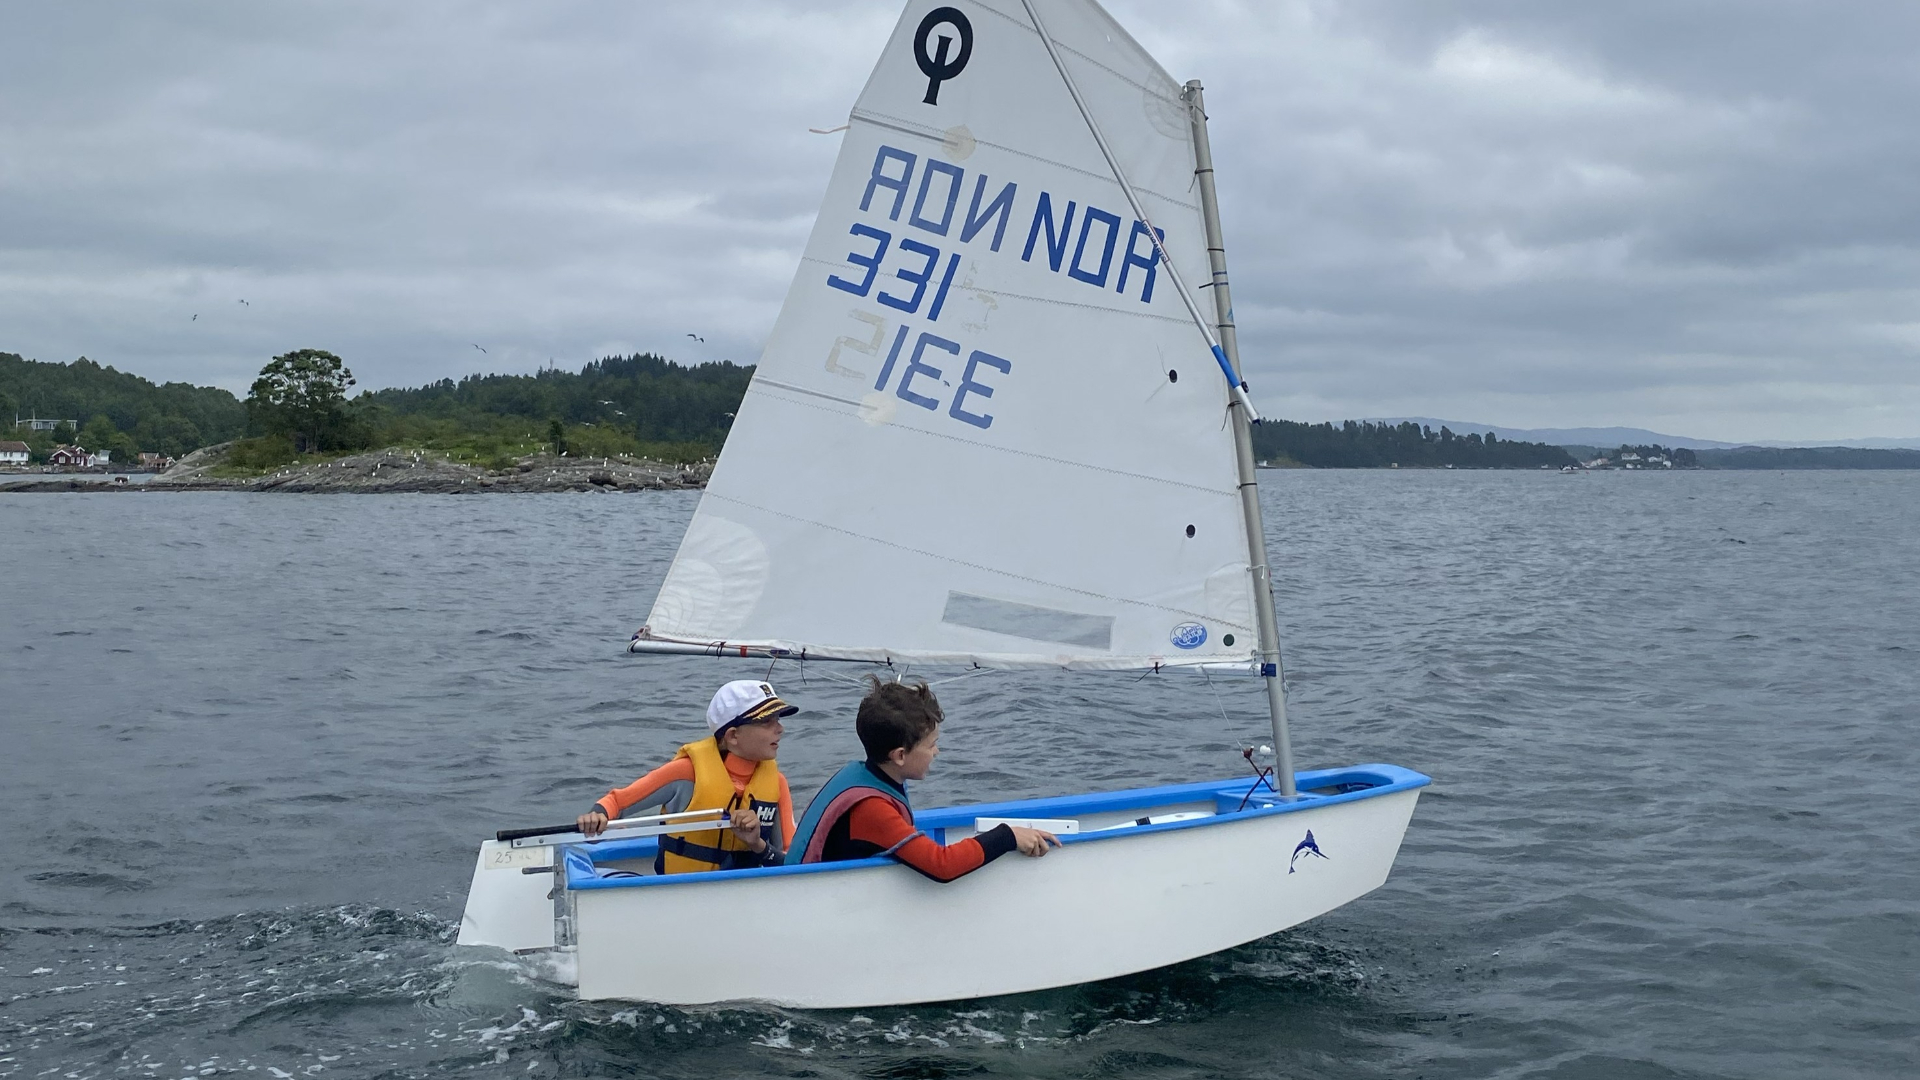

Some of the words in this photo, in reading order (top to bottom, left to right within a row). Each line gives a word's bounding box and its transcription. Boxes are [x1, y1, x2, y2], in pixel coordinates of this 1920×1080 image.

[827, 223, 961, 322] 331
[1021, 191, 1165, 303] NOR
[756, 806, 776, 820] HH
[494, 850, 513, 864] 25
